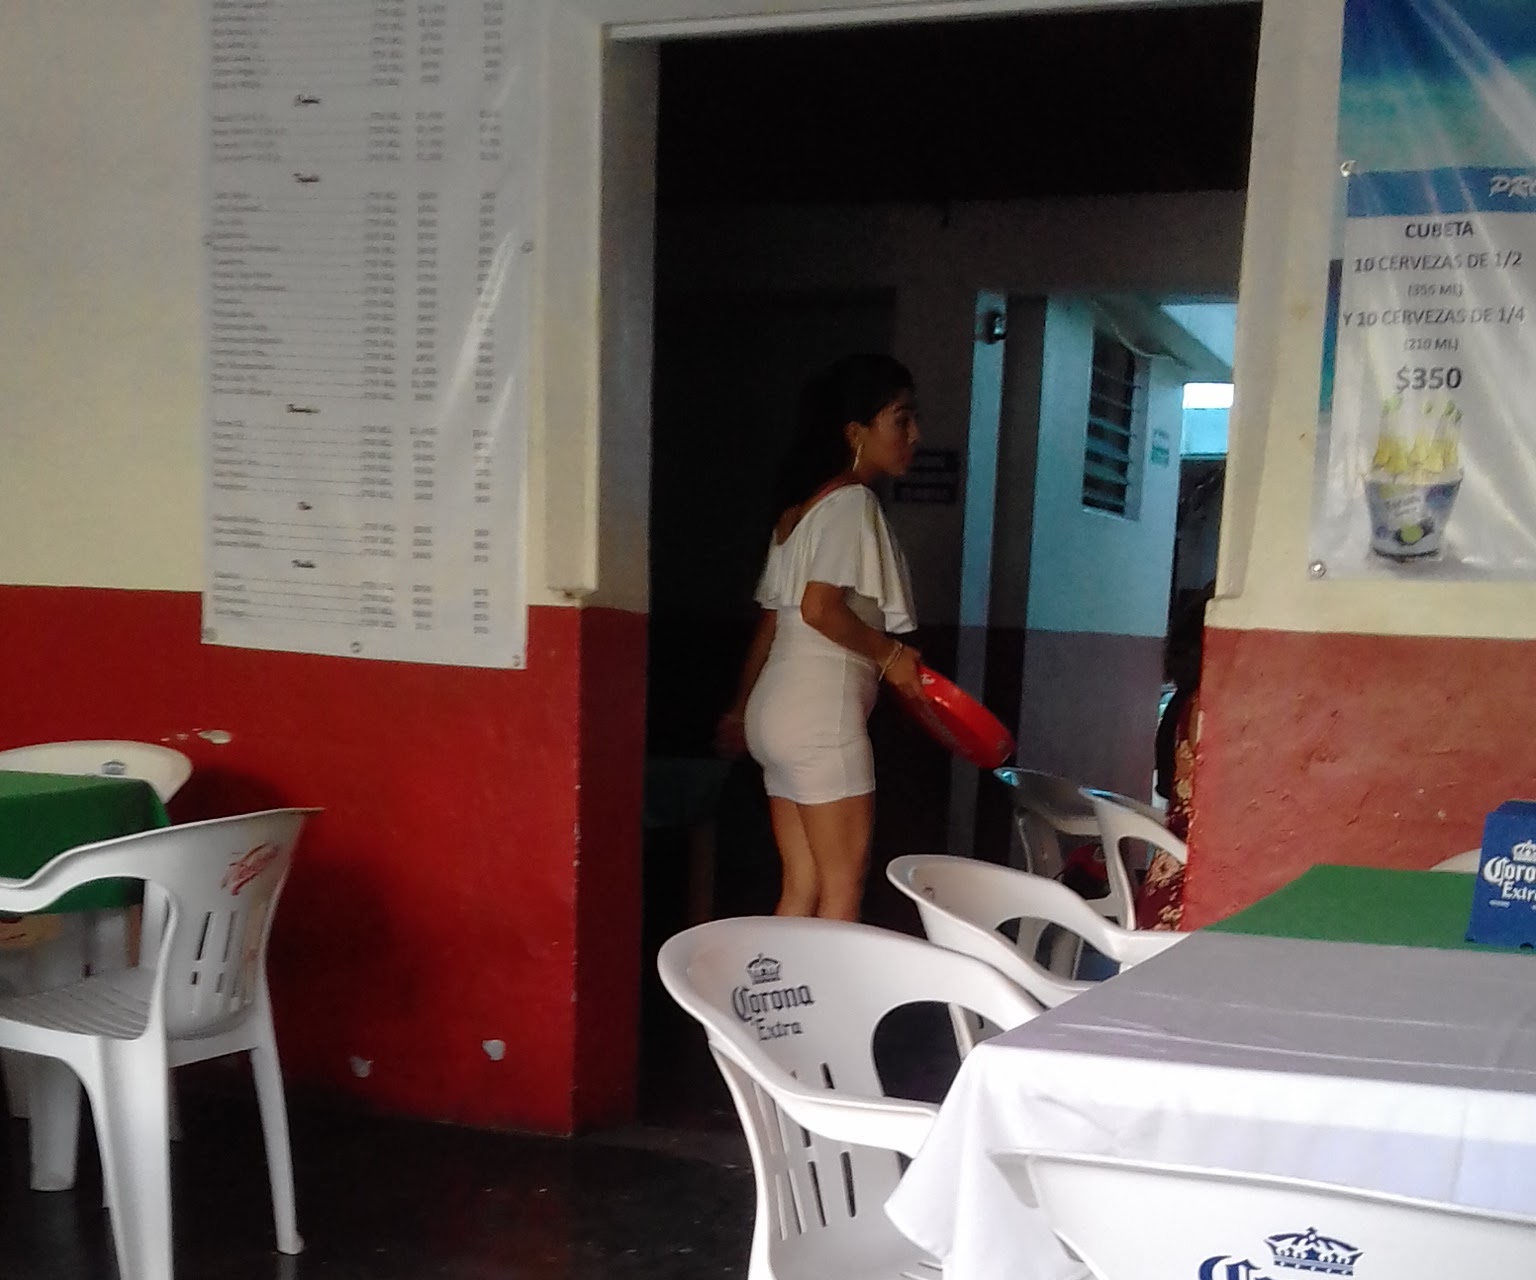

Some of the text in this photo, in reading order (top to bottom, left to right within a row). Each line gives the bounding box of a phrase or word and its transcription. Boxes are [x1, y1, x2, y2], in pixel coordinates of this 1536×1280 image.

[1405, 221, 1474, 238] CUBETA
[1354, 249, 1522, 272] 10 CERVEZAS DE 1/2
[1342, 306, 1526, 326] Y 10 CERVEZAS DE 1/4
[1396, 366, 1462, 394] $350
[1501, 880, 1536, 902] Extr
[731, 985, 816, 1023] Corona
[756, 1018, 804, 1041] Extra
